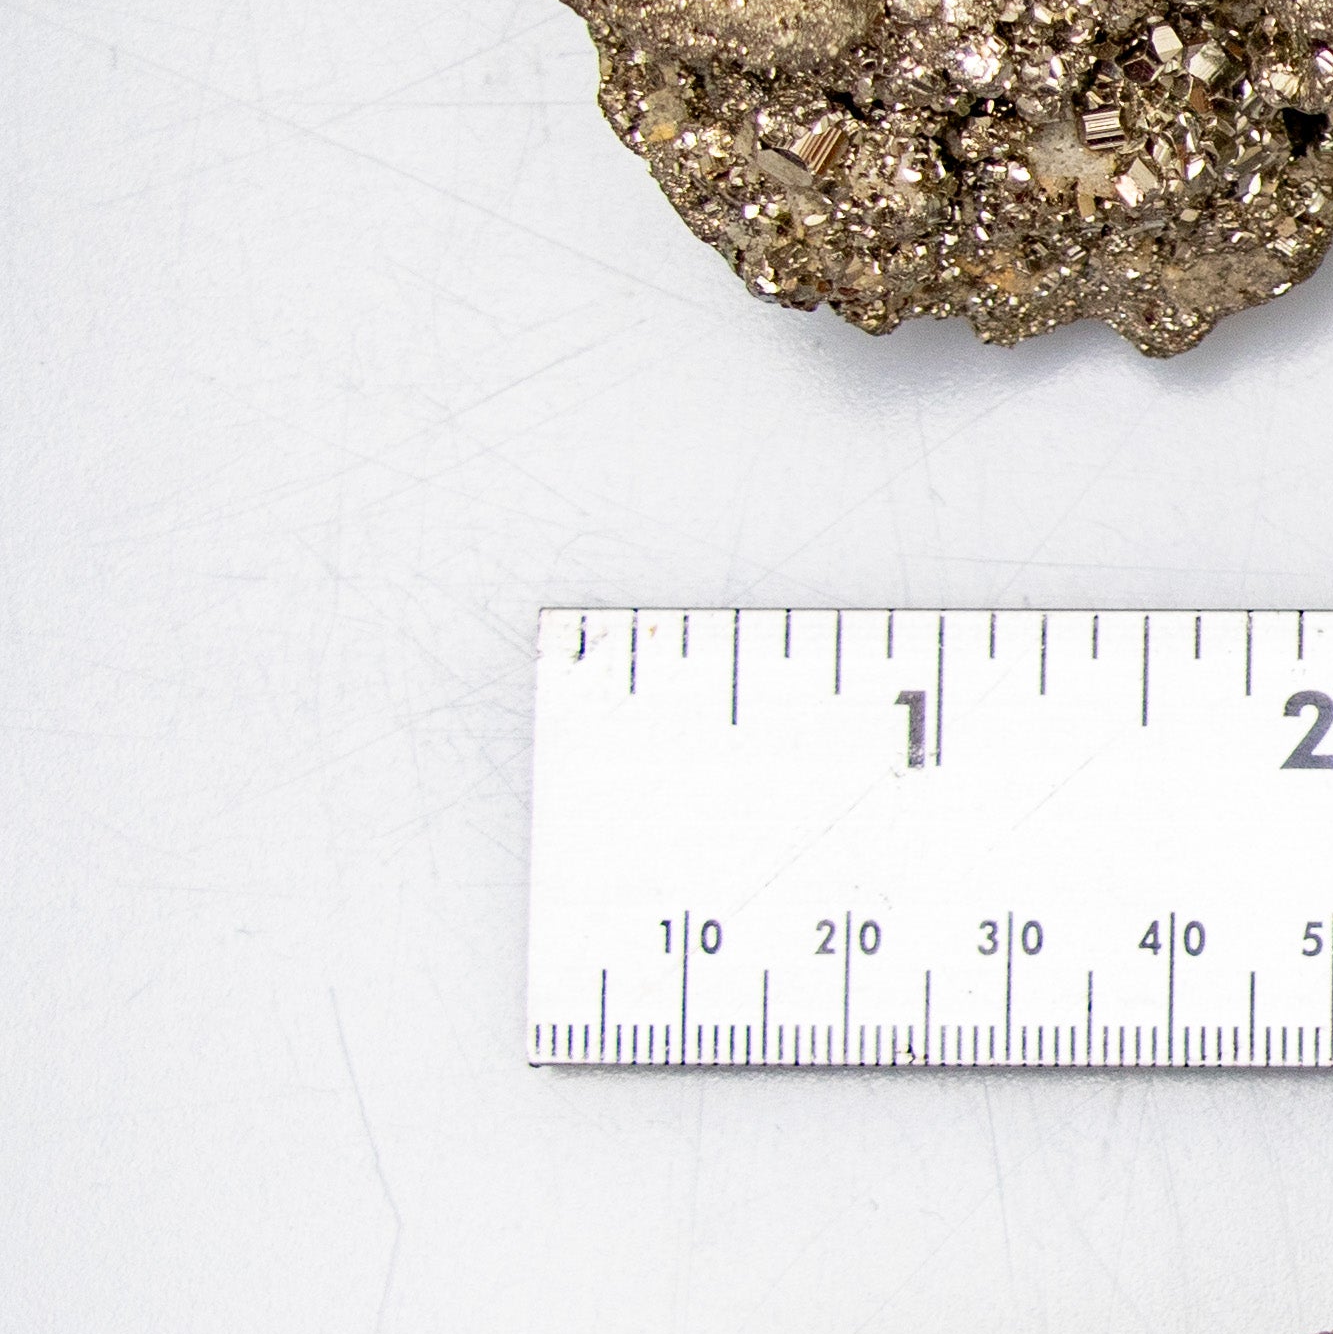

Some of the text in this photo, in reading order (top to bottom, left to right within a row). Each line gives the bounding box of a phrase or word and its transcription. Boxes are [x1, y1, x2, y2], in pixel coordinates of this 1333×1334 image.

[894, 690, 926, 769] 1
[660, 920, 723, 955] 10
[815, 920, 881, 955] 20
[977, 920, 1044, 955] 30
[1138, 920, 1206, 956] 40
